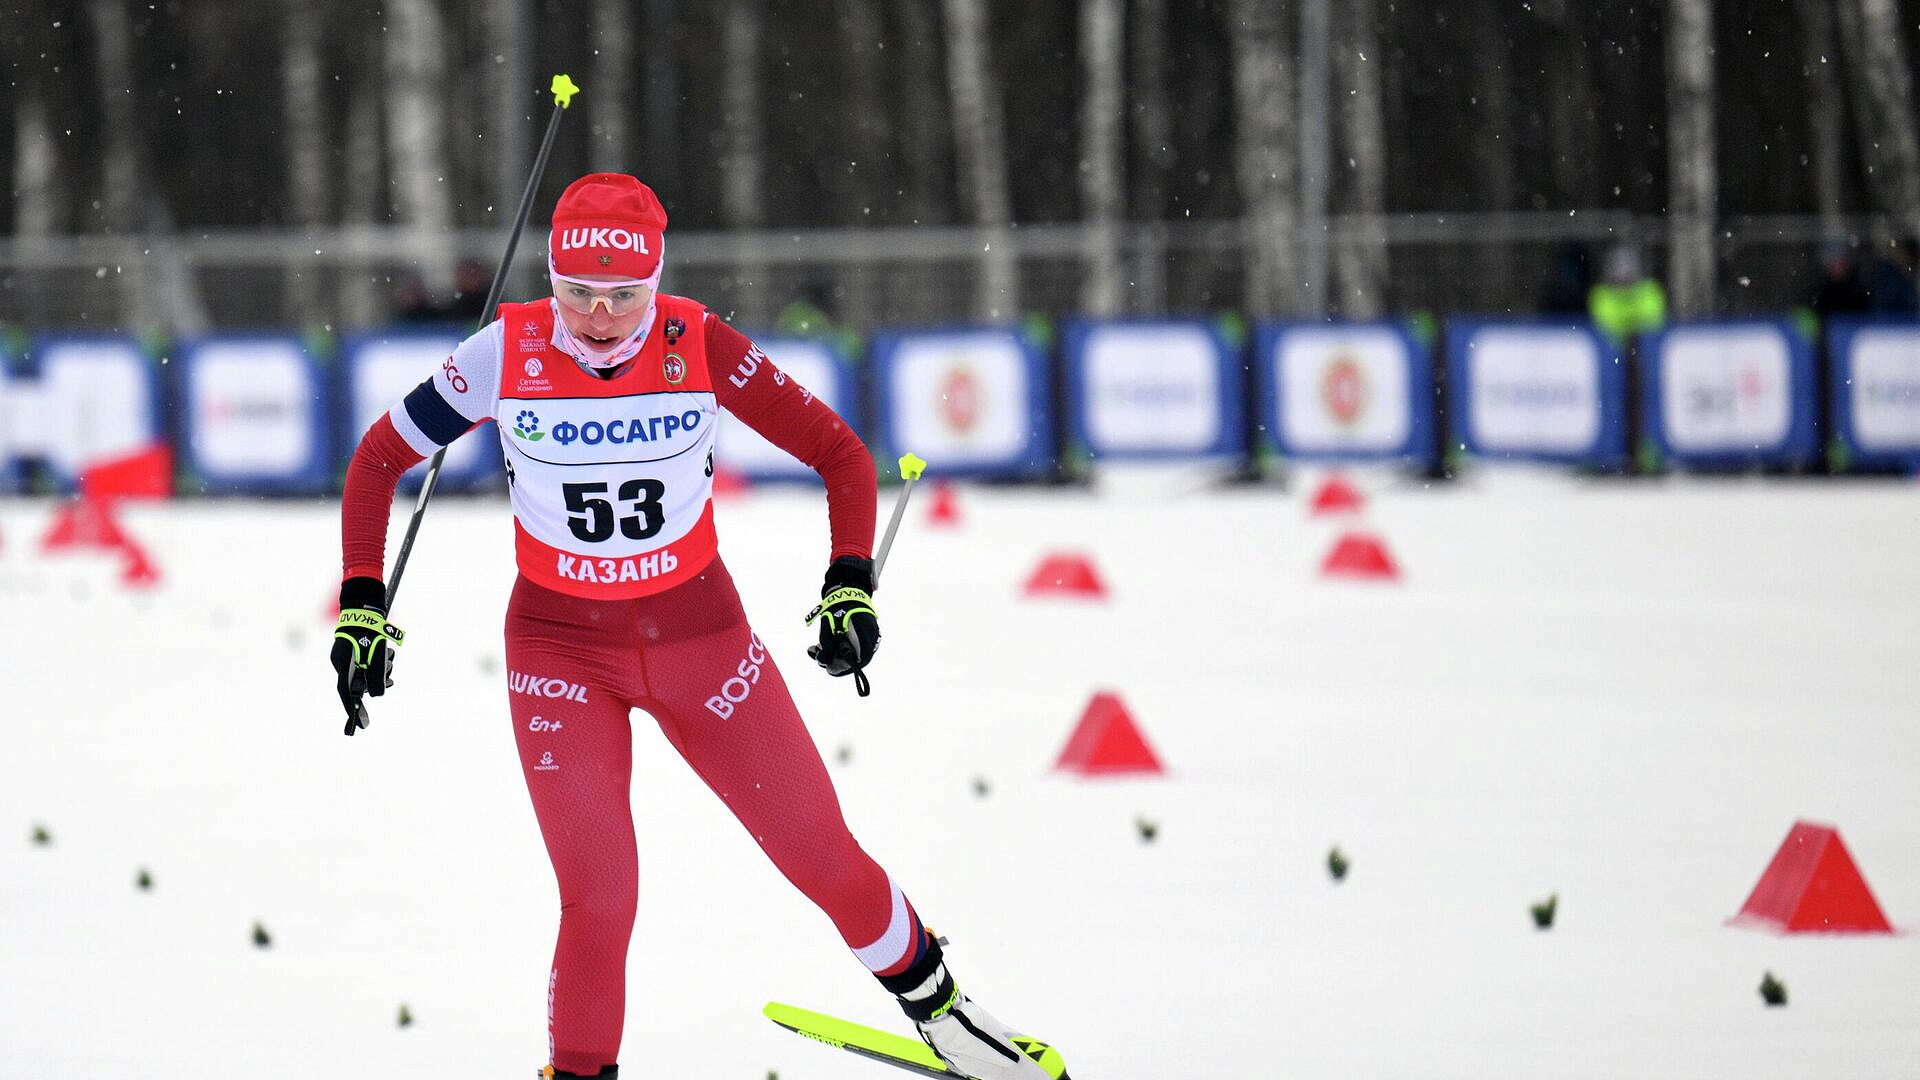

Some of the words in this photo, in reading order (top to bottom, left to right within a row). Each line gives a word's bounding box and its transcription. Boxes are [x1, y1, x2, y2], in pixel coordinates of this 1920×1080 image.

[561, 228, 649, 255] LUKOIL
[442, 354, 468, 394] SCO
[728, 341, 765, 389] LUK
[551, 409, 701, 446] ФОСАГРО
[562, 478, 666, 543] 53
[556, 550, 679, 584] КАЗАНЬ
[509, 670, 588, 704] LUKOIL
[528, 715, 563, 732] En+
